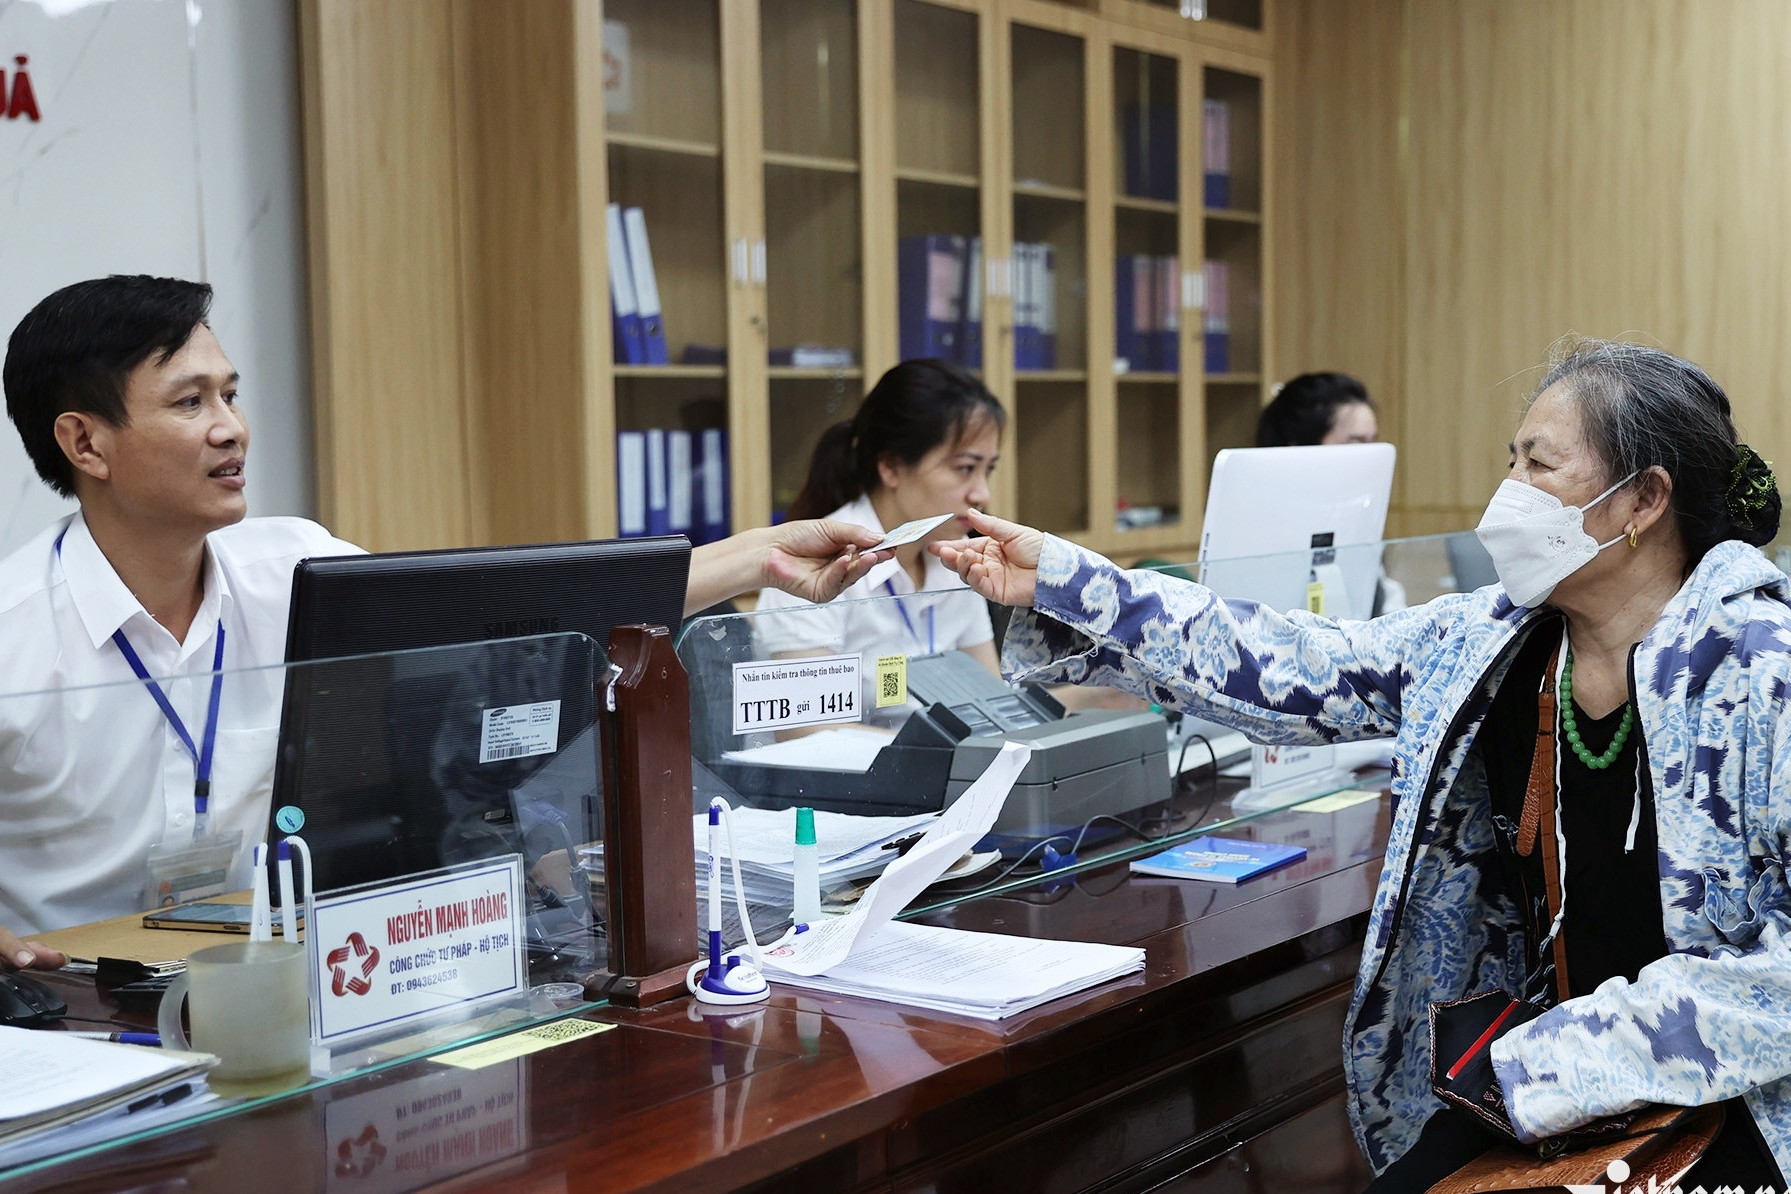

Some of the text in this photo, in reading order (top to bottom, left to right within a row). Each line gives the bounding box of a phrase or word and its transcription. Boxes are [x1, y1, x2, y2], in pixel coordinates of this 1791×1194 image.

[485, 616, 559, 638] SAMSUNG
[761, 672, 771, 682] tin
[789, 669, 799, 679] tra
[800, 667, 818, 679] thông
[819, 666, 828, 676] tin
[829, 664, 843, 675] thuê
[843, 664, 855, 674] bao
[741, 690, 854, 724] TTTB gửi 1414
[387, 889, 508, 946] NGUYỄN MẠNH HOÀNG
[390, 955, 413, 975] CÔNG
[415, 947, 437, 969] CHỨC
[439, 945, 450, 961] TƯ
[451, 940, 472, 960] PHÁP
[480, 935, 490, 955] HỘ
[492, 932, 509, 952] TỊCH
[391, 968, 459, 996] ĐT: 0943624538
